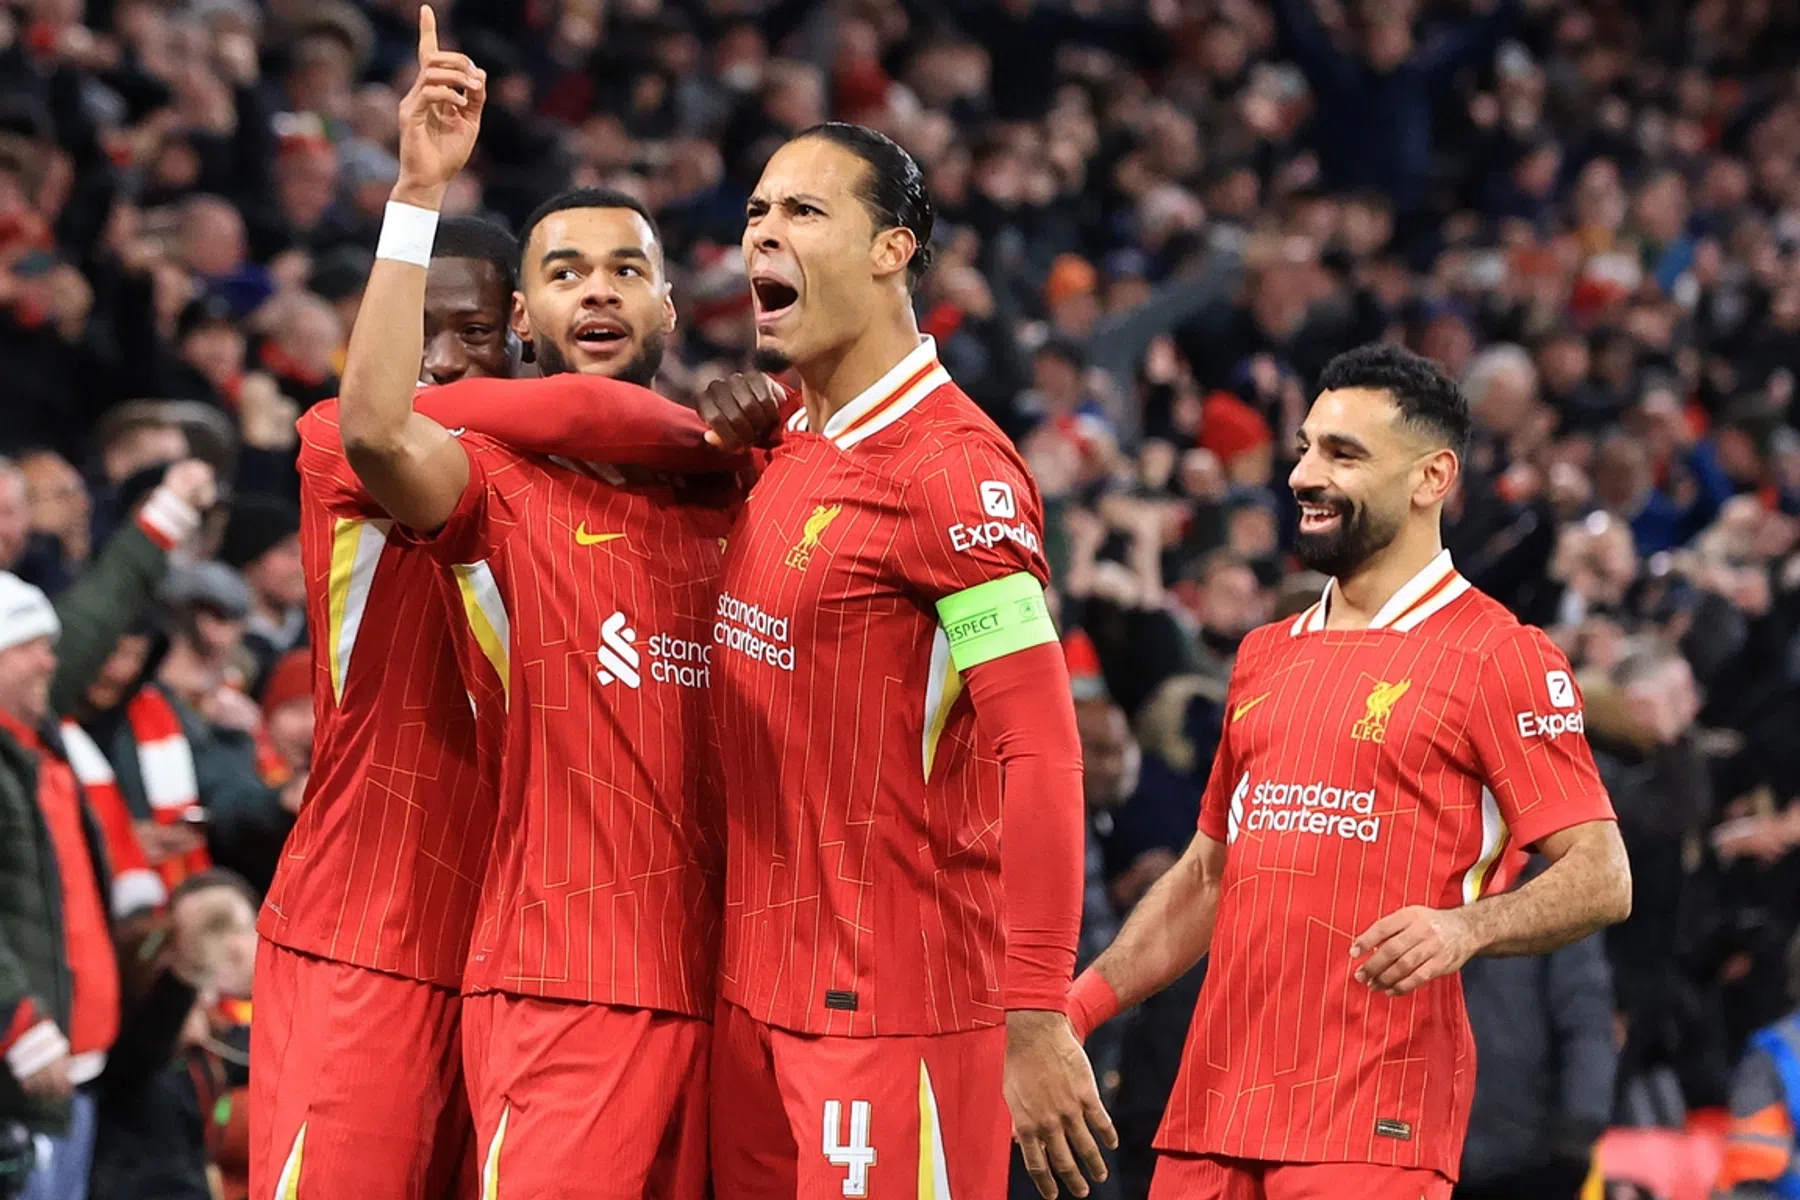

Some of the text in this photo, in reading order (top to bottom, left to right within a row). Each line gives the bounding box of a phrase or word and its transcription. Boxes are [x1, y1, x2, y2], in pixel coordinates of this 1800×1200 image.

[717, 591, 788, 643] standard
[713, 620, 795, 672] chartered
[1251, 779, 1376, 815] standard
[1246, 805, 1380, 843] chartered
[823, 1100, 877, 1198] 4
